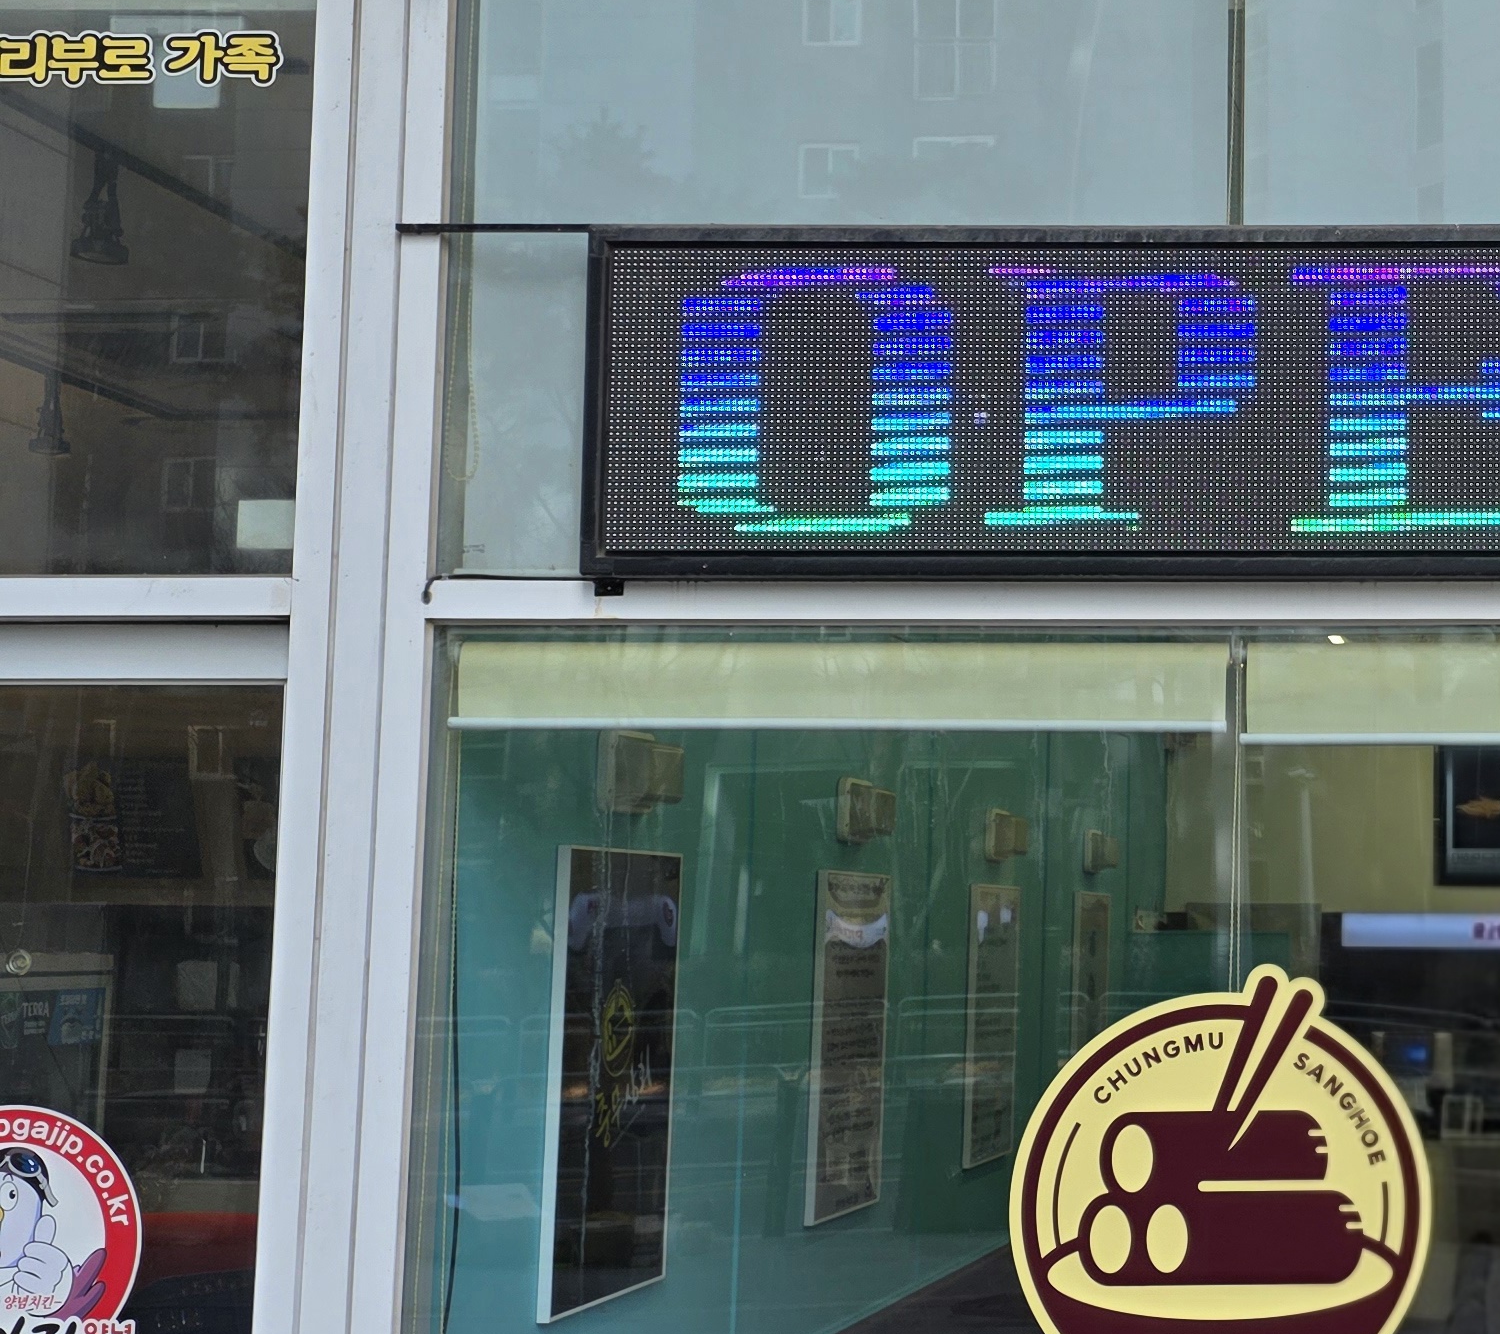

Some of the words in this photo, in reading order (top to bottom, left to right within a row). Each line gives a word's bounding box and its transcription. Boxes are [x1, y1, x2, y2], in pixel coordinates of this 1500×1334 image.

[168, 34, 277, 82] 가족
[1092, 1030, 1226, 1105] CHUNGMU
[1292, 1050, 1387, 1167] SANGHOE
